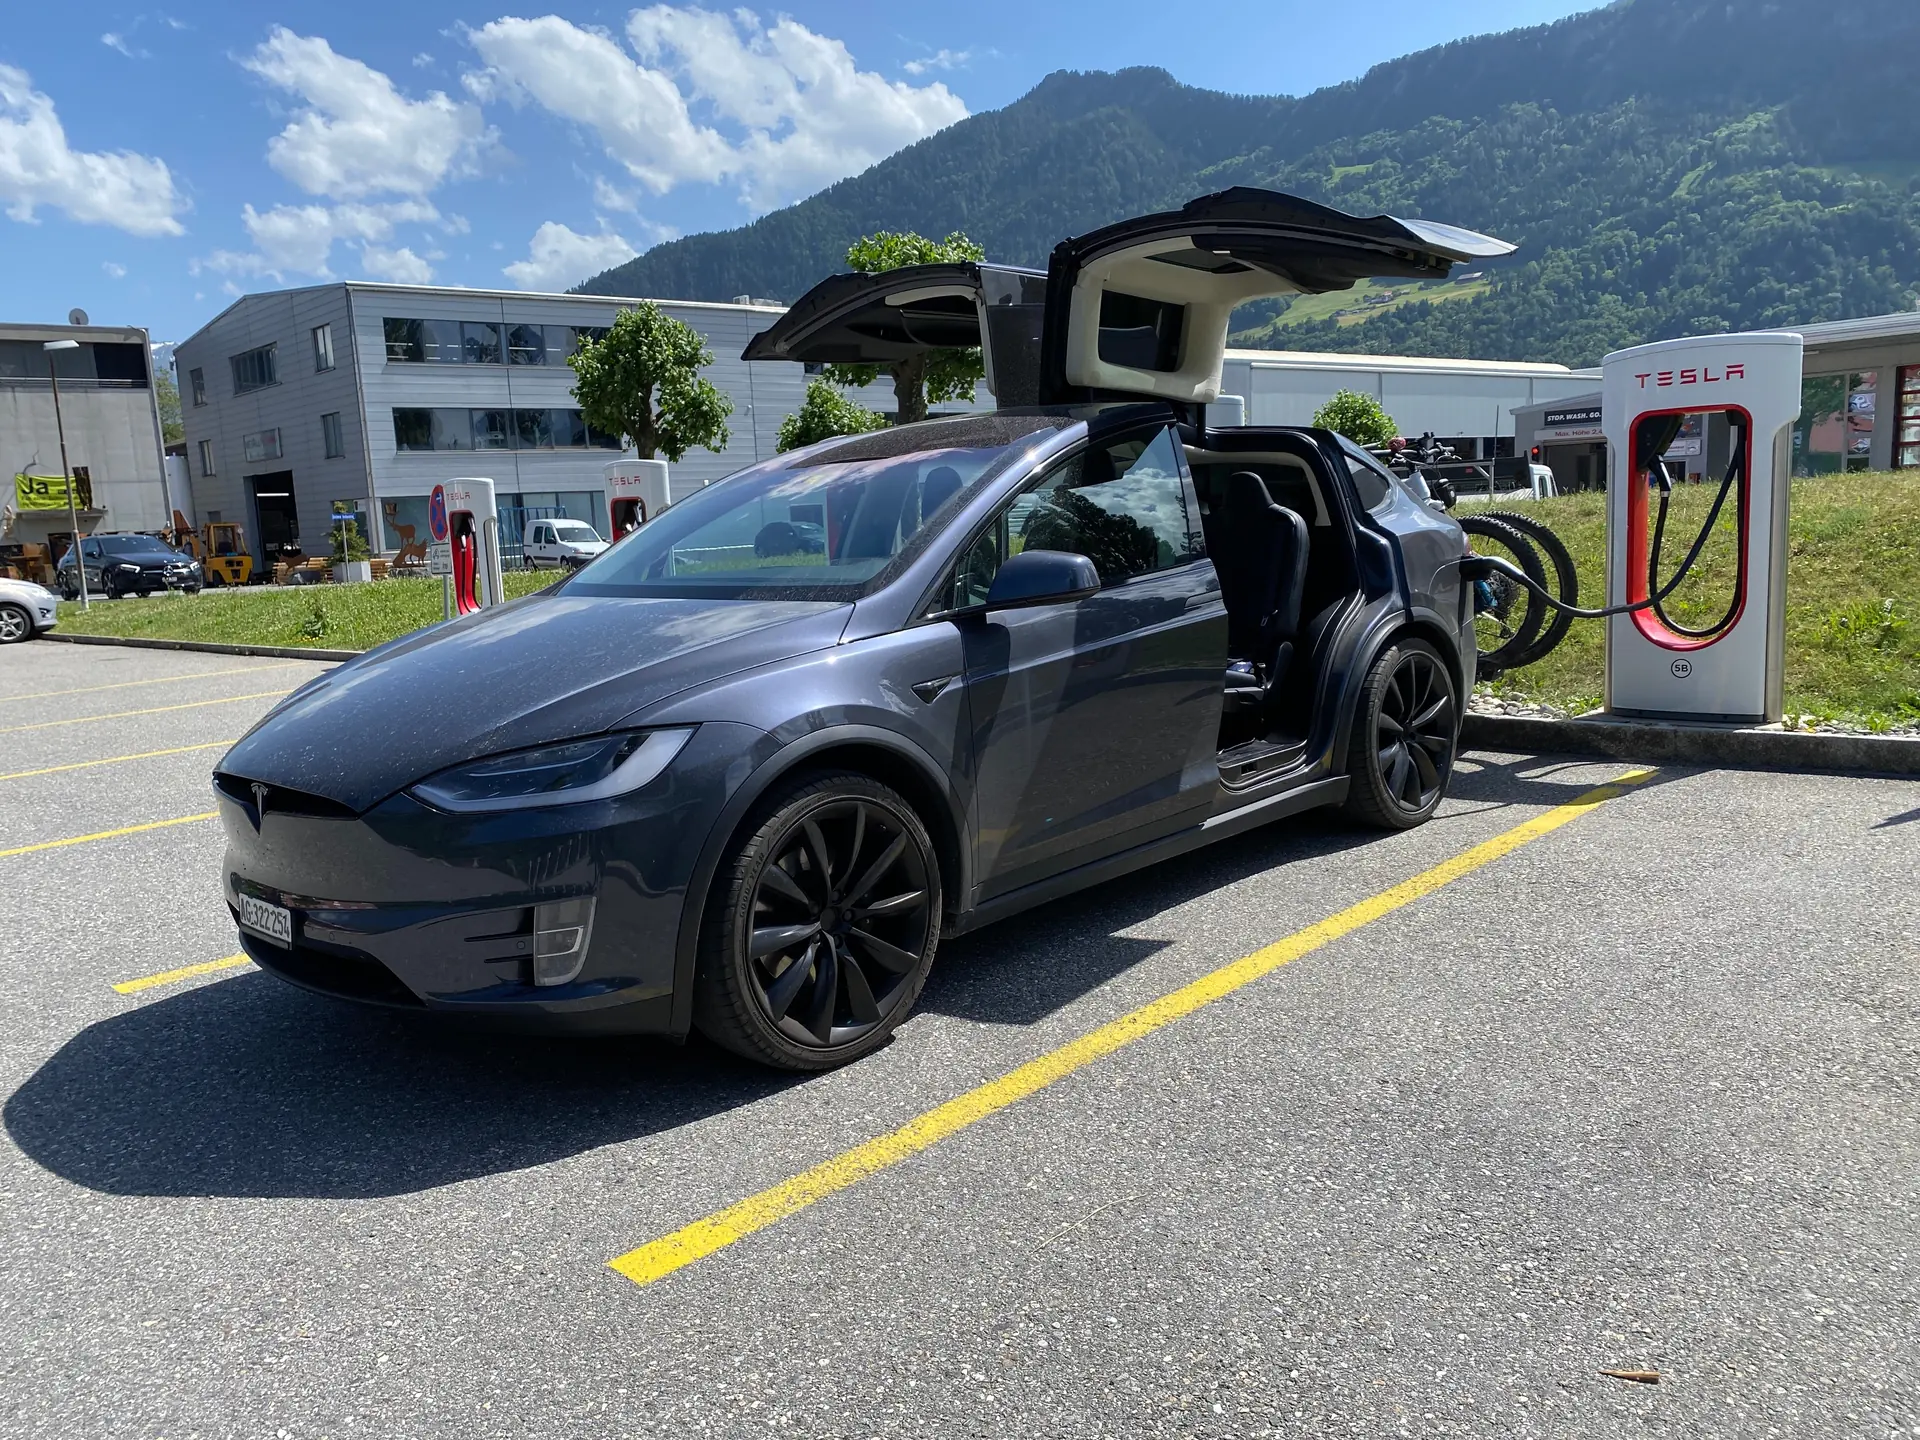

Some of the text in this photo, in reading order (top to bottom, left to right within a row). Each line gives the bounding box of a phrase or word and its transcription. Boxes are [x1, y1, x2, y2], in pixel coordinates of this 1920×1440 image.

[1634, 363, 1745, 389] TESLA
[22, 477, 49, 495] Ja
[608, 475, 641, 486] TESLA
[446, 491, 471, 501] TESLA
